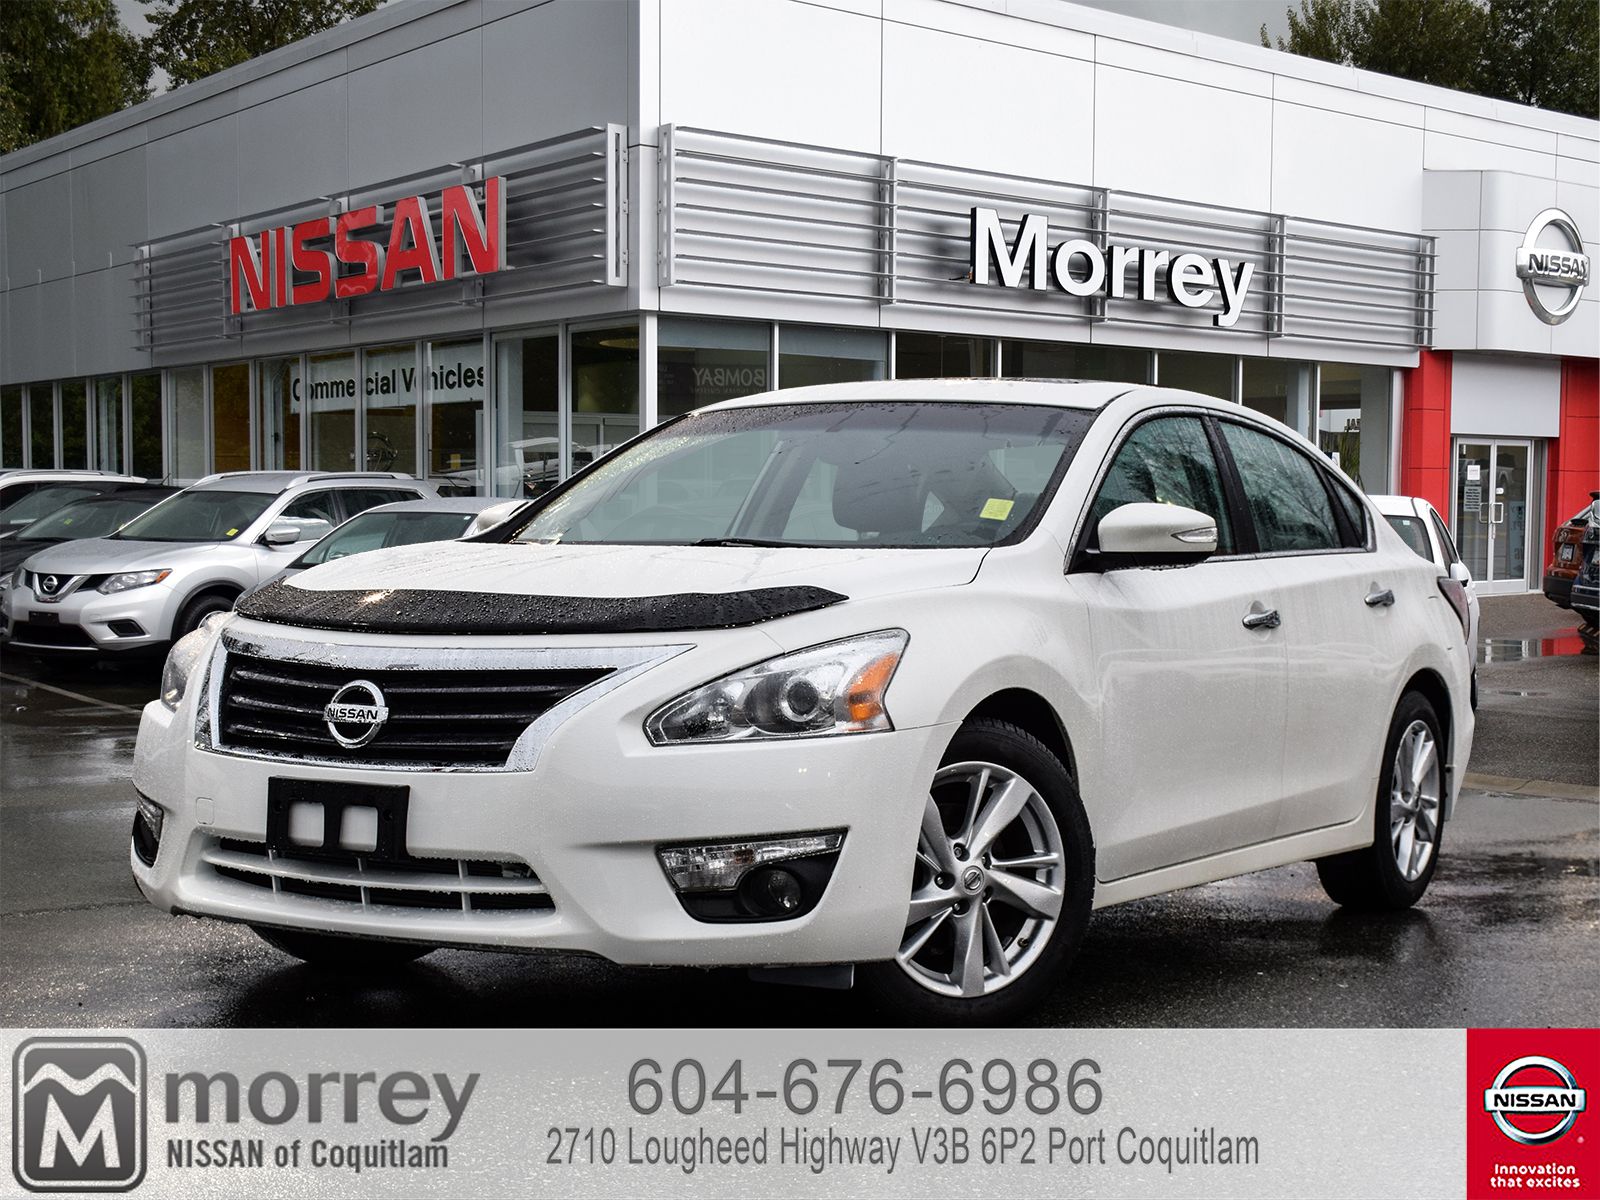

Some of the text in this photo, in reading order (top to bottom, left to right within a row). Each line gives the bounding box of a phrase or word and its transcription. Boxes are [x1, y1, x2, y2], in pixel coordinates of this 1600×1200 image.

[230, 176, 507, 315] NISSAN
[970, 206, 1256, 327] Morrey
[1528, 253, 1588, 280] NISSAN
[327, 707, 378, 720] NISSAN
